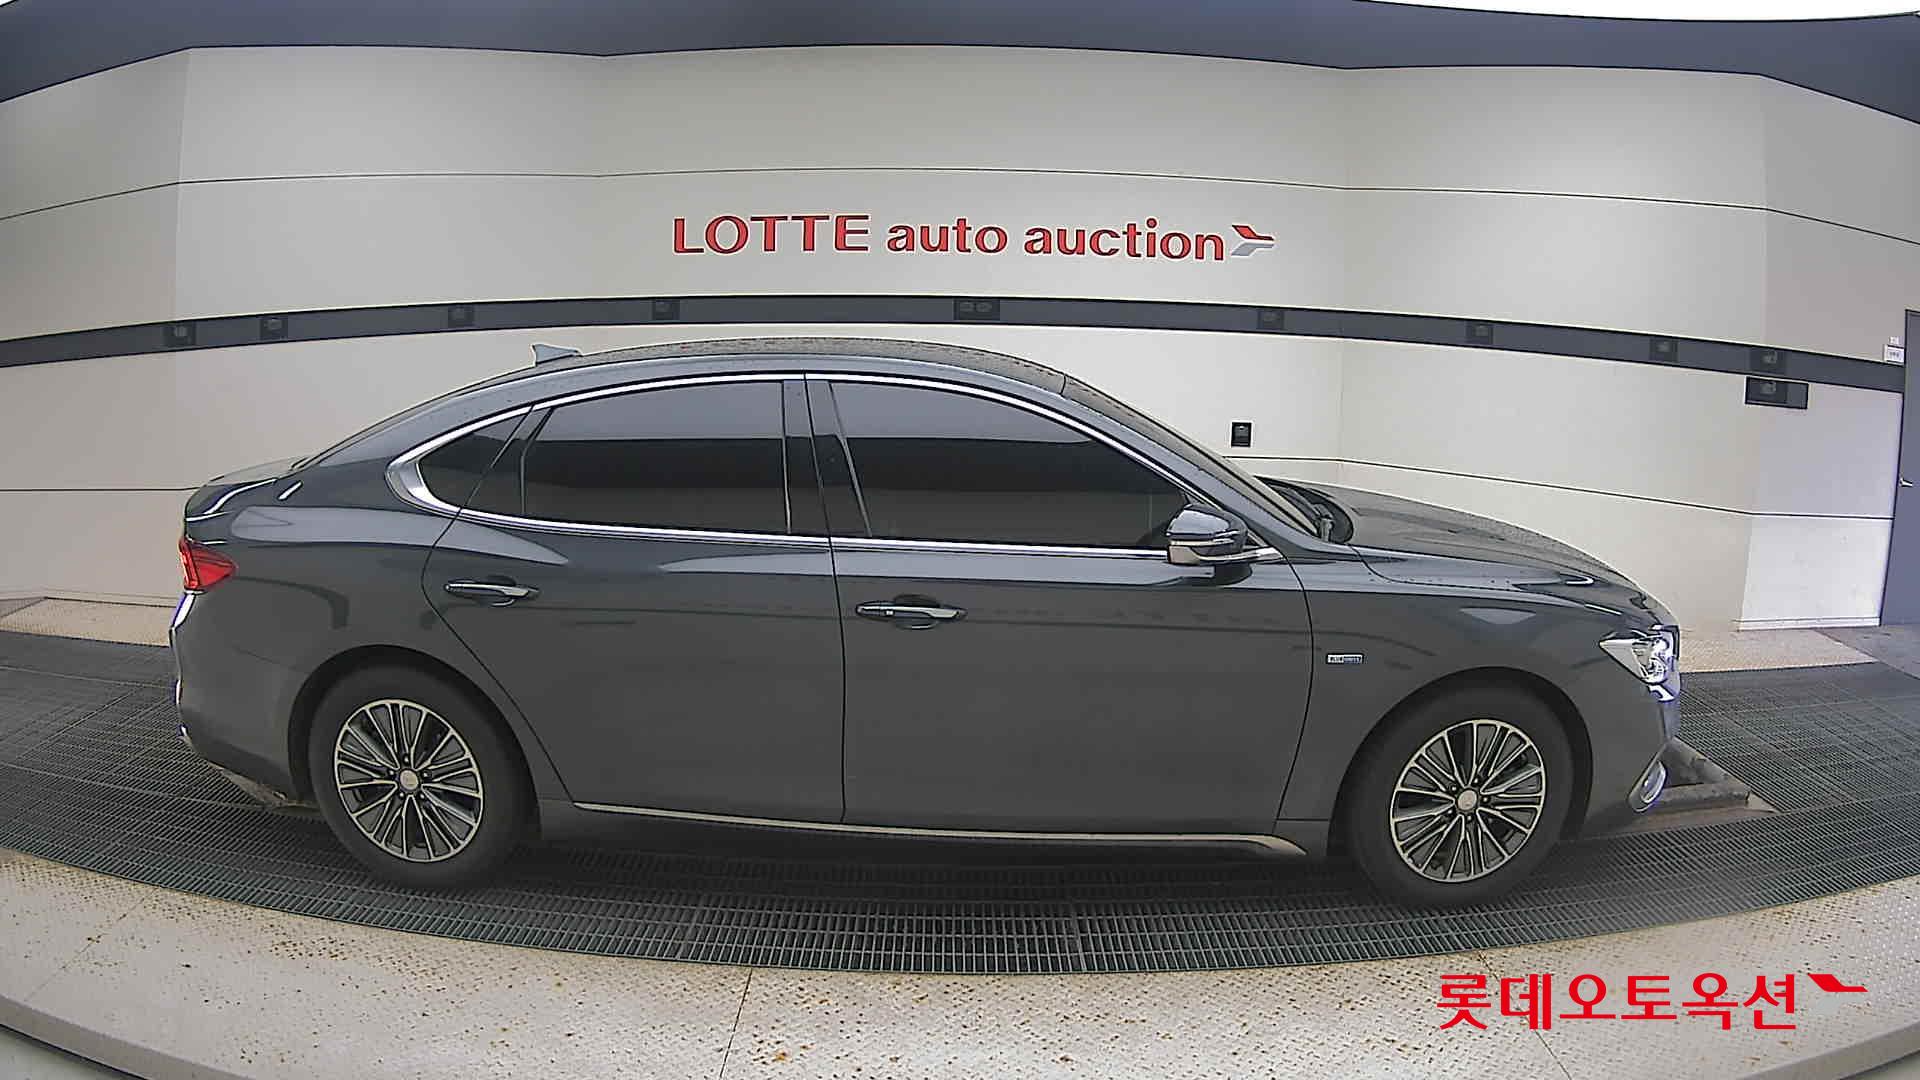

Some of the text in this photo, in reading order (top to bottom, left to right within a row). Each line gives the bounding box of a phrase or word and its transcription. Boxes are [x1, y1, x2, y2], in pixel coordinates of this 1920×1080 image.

[673, 214, 1225, 261] LOTTE auto auction
